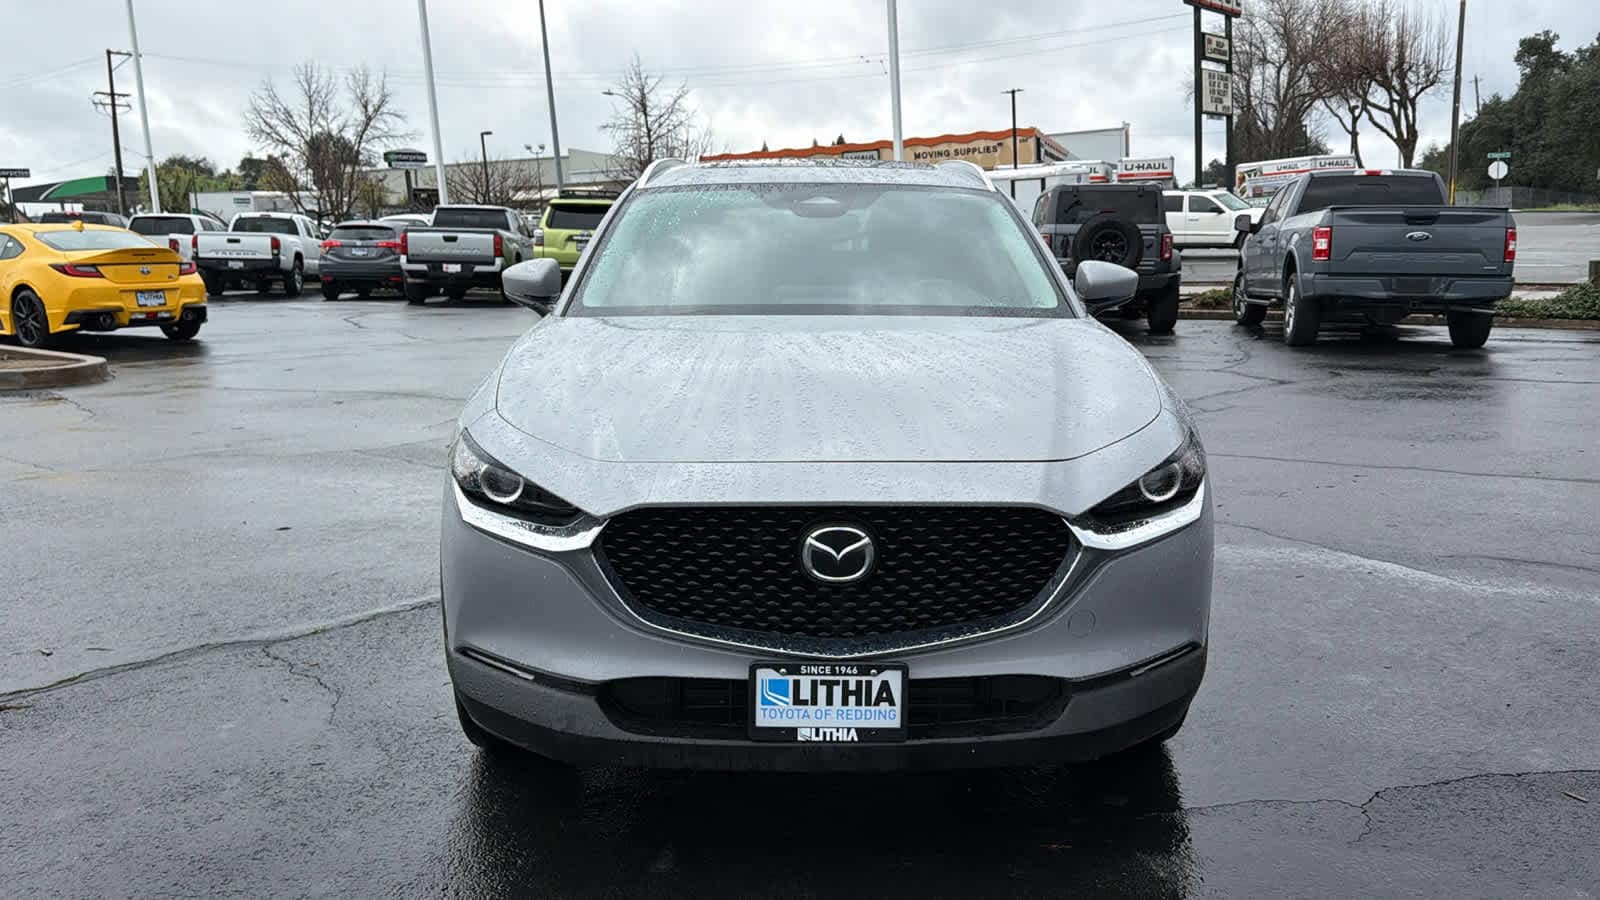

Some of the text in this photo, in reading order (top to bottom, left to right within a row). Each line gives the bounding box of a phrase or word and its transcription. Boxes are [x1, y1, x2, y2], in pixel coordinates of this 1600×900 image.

[914, 150, 950, 160] MOVING
[1124, 162, 1168, 171] U-HAUL
[1320, 158, 1350, 167] U-HAUL
[800, 665, 858, 674] SINCE 1946
[792, 679, 896, 706] LITHIA
[760, 708, 896, 721] TOYOTA OF REDDING
[811, 728, 858, 741] LITHIA
